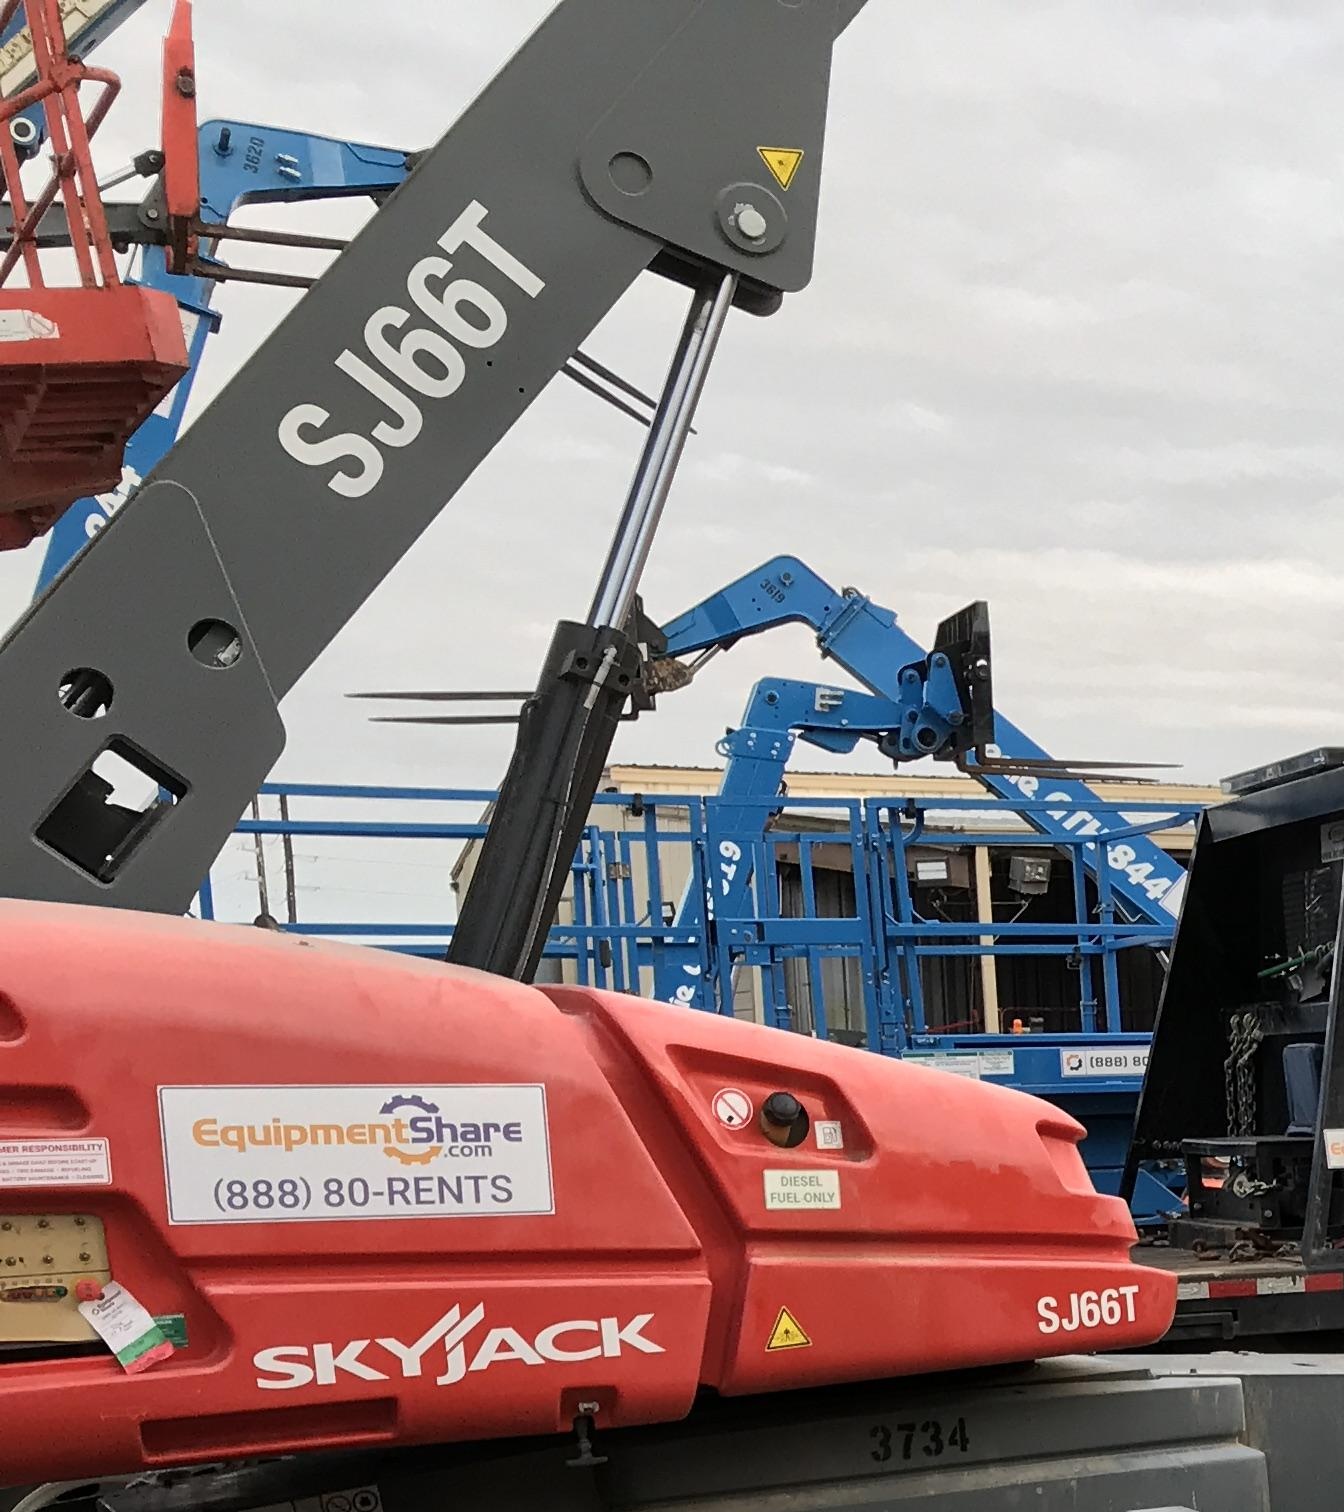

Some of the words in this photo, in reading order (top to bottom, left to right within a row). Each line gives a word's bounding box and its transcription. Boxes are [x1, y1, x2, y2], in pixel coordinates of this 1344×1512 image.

[242, 136, 265, 174] 3620
[278, 199, 546, 498] SJ66T
[760, 579, 786, 604] 3619
[1090, 1056, 1128, 1069] (888)
[192, 1115, 523, 1153] EquipmentShare
[443, 1144, 493, 1159] .com
[213, 1176, 312, 1213] (888)
[323, 1174, 514, 1209] 80-RENTS
[770, 1192, 801, 1204] FUEL
[803, 1191, 836, 1204] ONLY
[780, 1175, 824, 1188] DIESEL
[1037, 1284, 1140, 1335] SJ66T
[252, 1300, 667, 1390] SKYJACK
[869, 1417, 970, 1462] 3734
